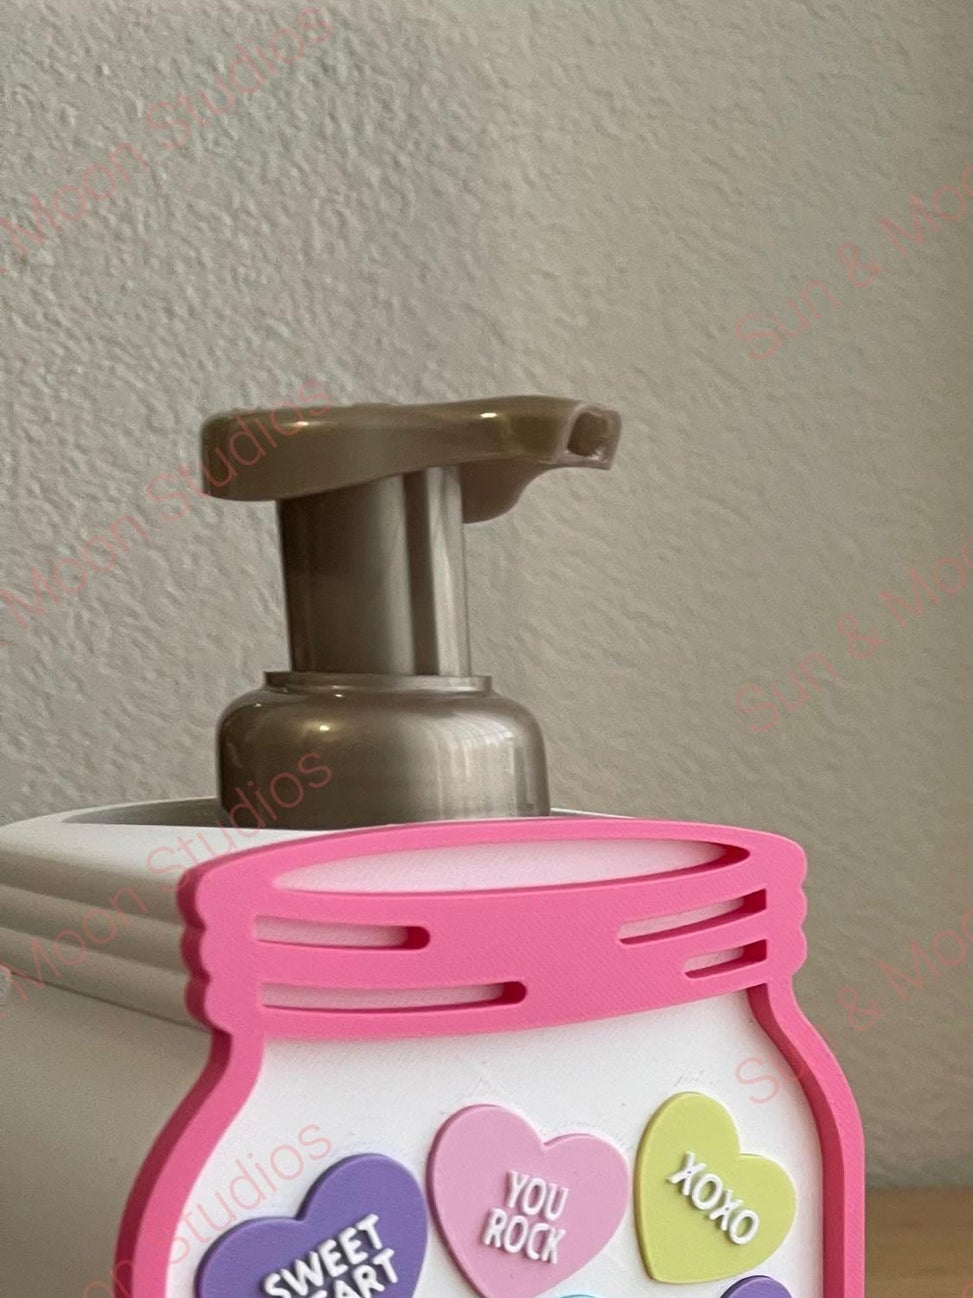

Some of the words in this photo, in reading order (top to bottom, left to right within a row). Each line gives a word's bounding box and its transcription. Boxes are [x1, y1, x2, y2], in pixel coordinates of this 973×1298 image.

[504, 1170, 569, 1221] YOU
[667, 1151, 760, 1246] XOXO
[482, 1207, 568, 1265] ROCK
